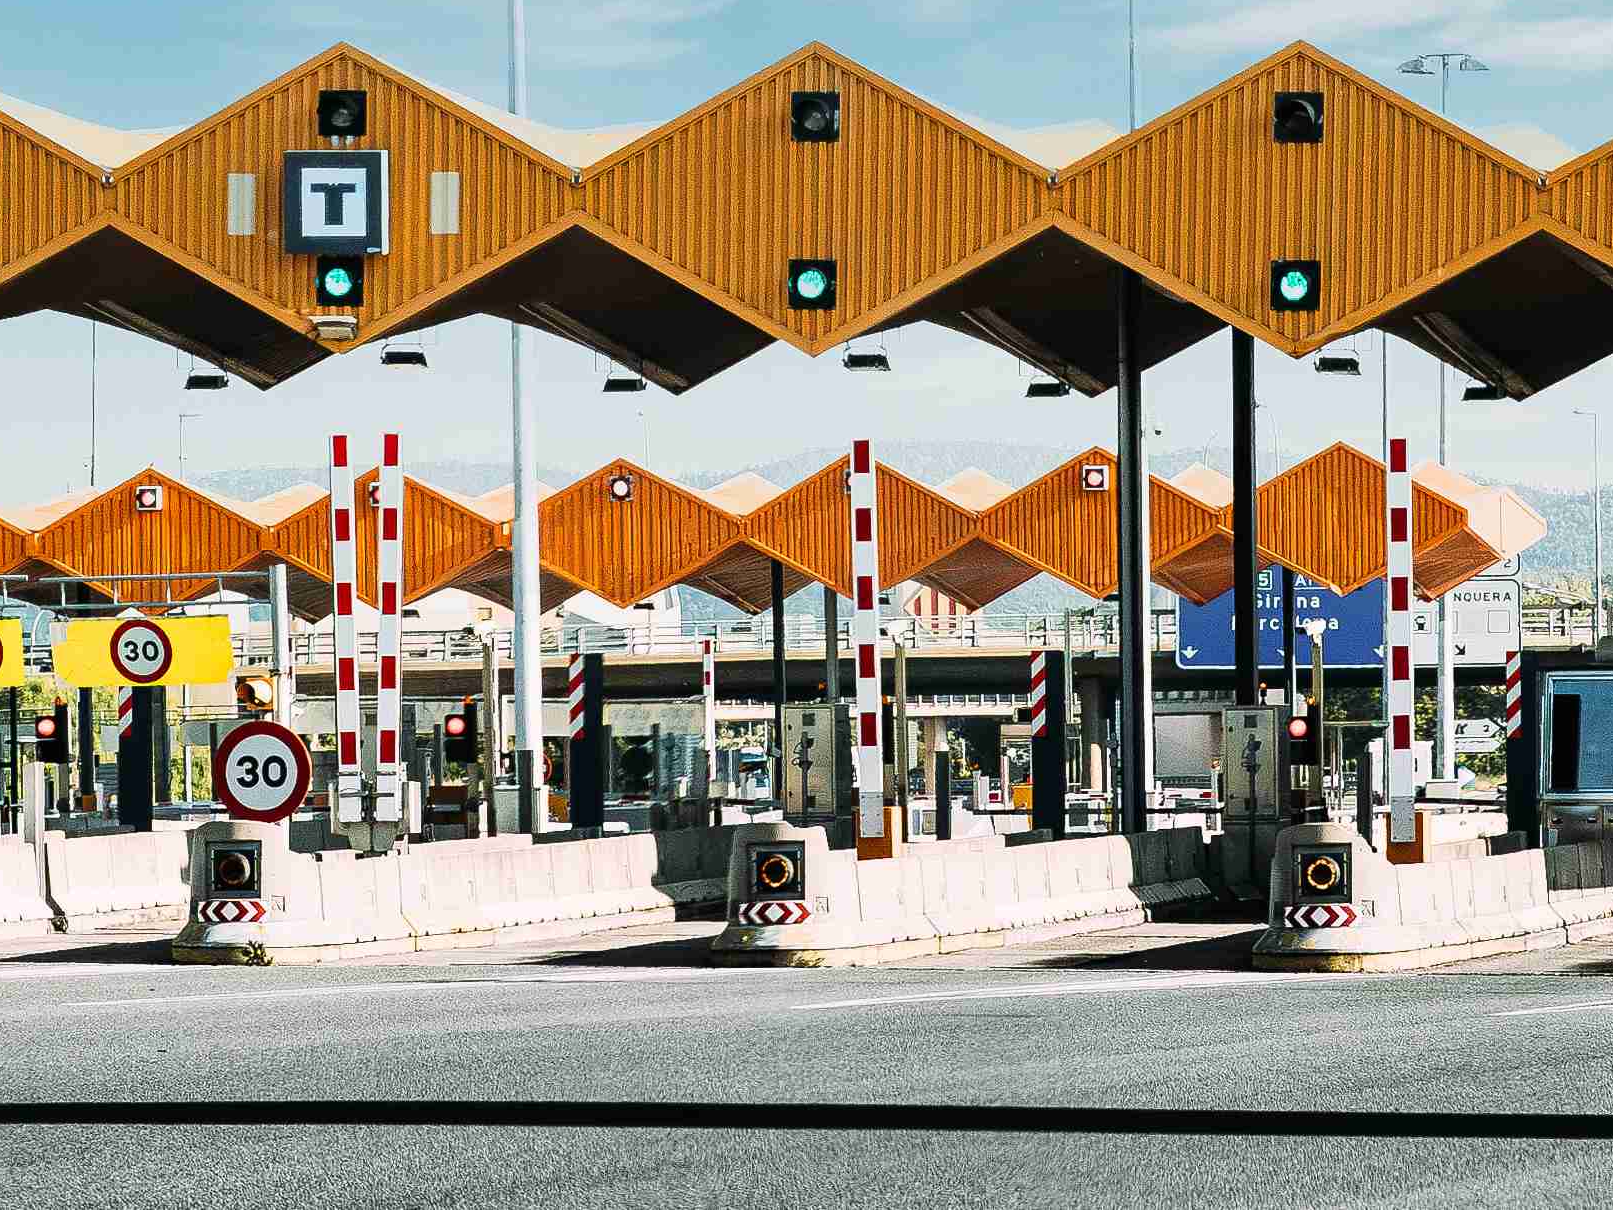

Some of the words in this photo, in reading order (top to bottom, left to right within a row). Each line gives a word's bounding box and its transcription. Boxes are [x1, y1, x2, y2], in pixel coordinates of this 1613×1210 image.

[310, 183, 356, 225] T
[1256, 593, 1321, 609] Girna
[123, 640, 159, 662] 30
[235, 755, 288, 788] 30
